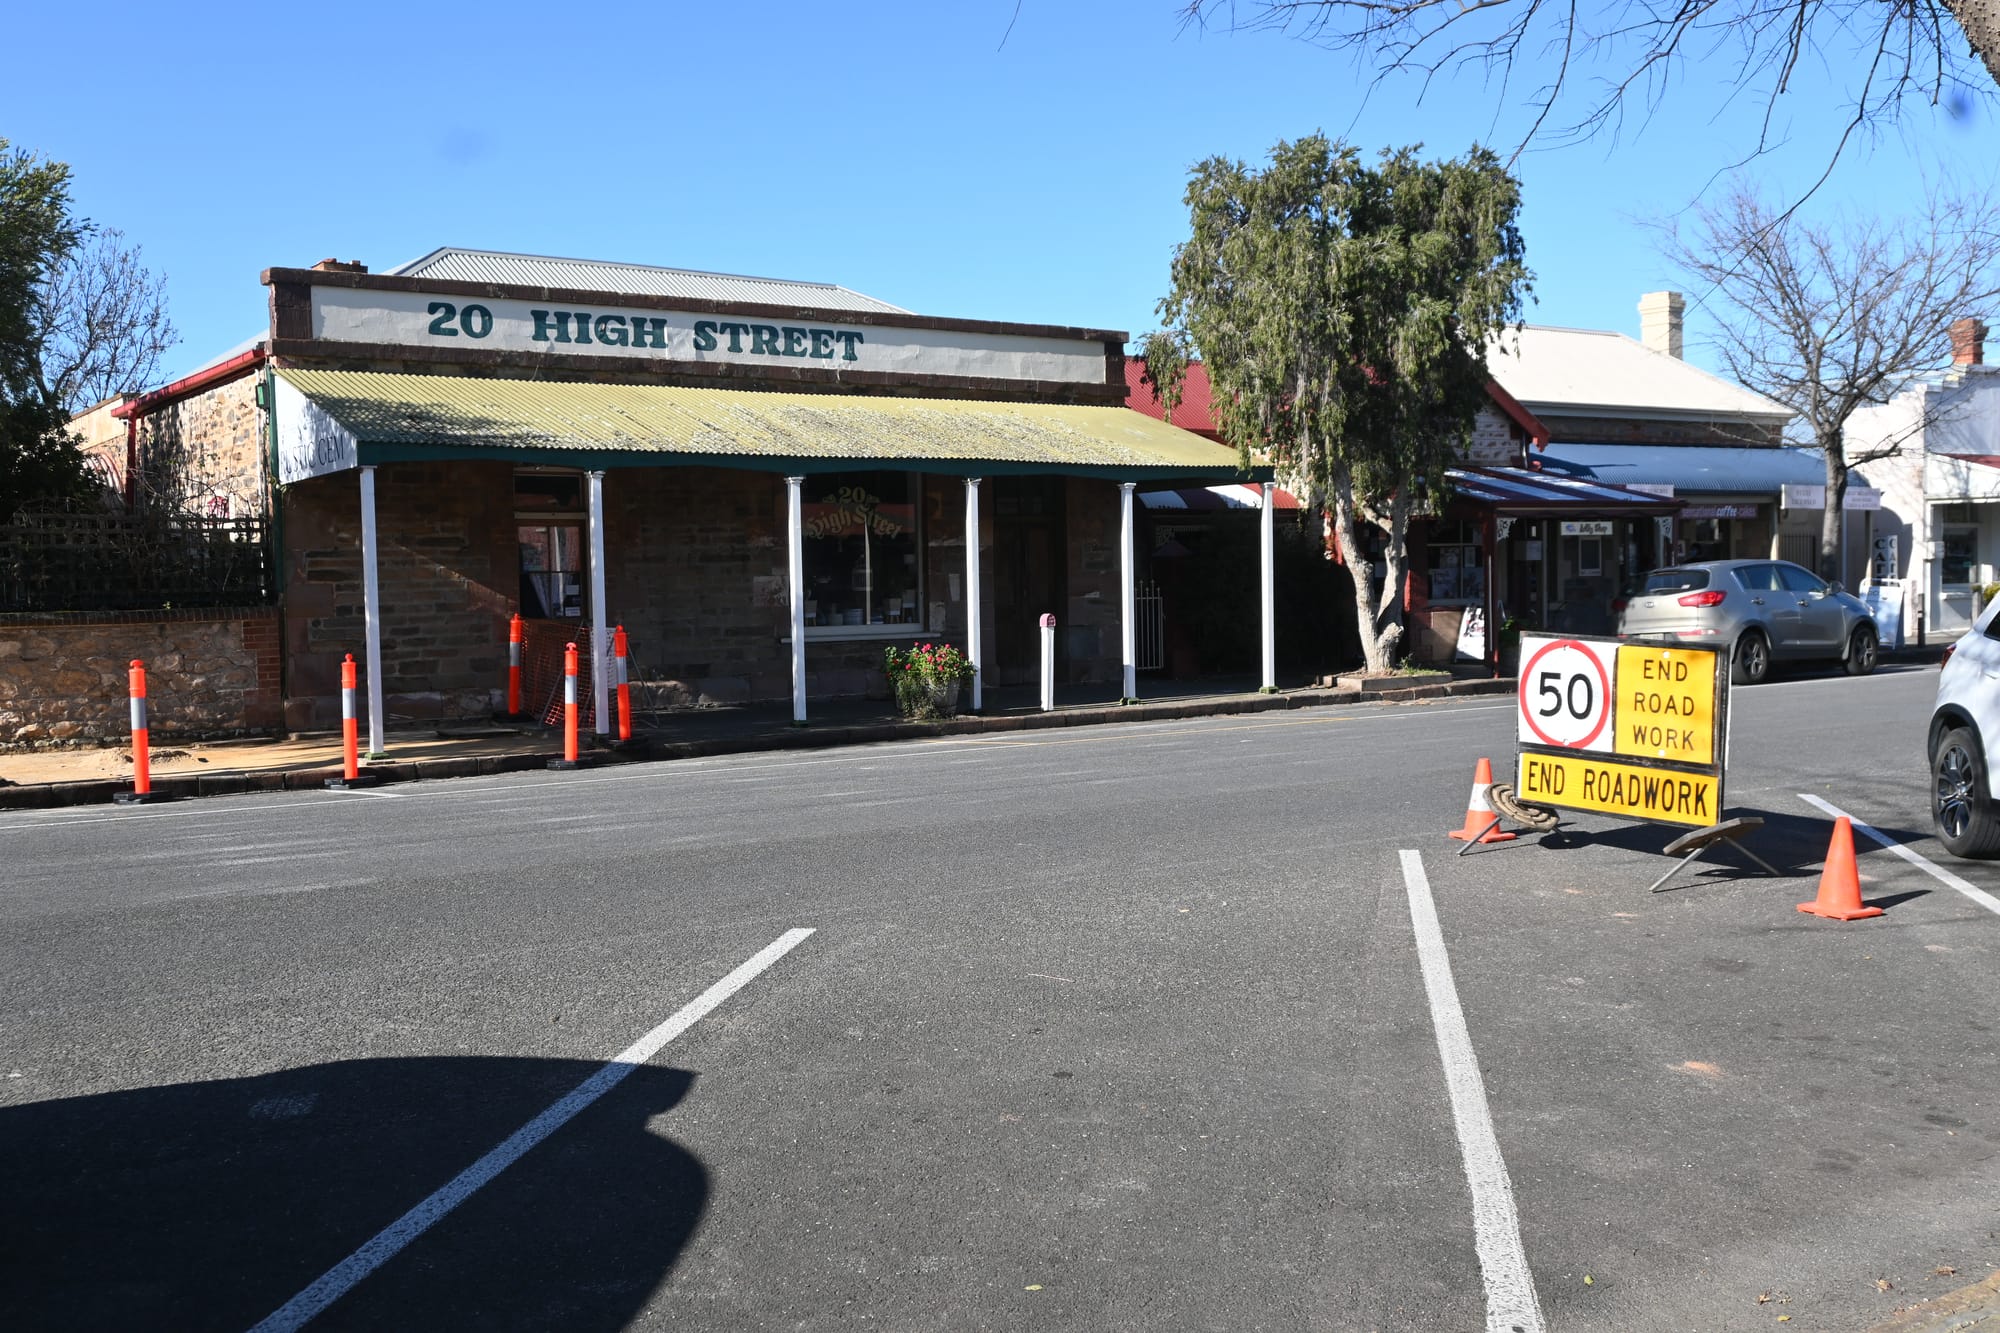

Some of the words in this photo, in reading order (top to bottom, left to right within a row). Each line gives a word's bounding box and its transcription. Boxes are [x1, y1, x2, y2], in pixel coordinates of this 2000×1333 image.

[427, 302, 494, 338] 20
[530, 309, 669, 349] HIGH
[693, 320, 864, 361] STREET
[318, 433, 345, 466] GEM
[838, 486, 866, 503] 20
[804, 506, 851, 539] High
[852, 503, 903, 538] Street
[1643, 659, 1688, 682] END
[1539, 671, 1593, 720] 50
[1634, 692, 1695, 716] ROAD
[1632, 724, 1695, 751] WORK
[1528, 761, 1565, 795] END
[1583, 768, 1708, 817] ROADWORK
